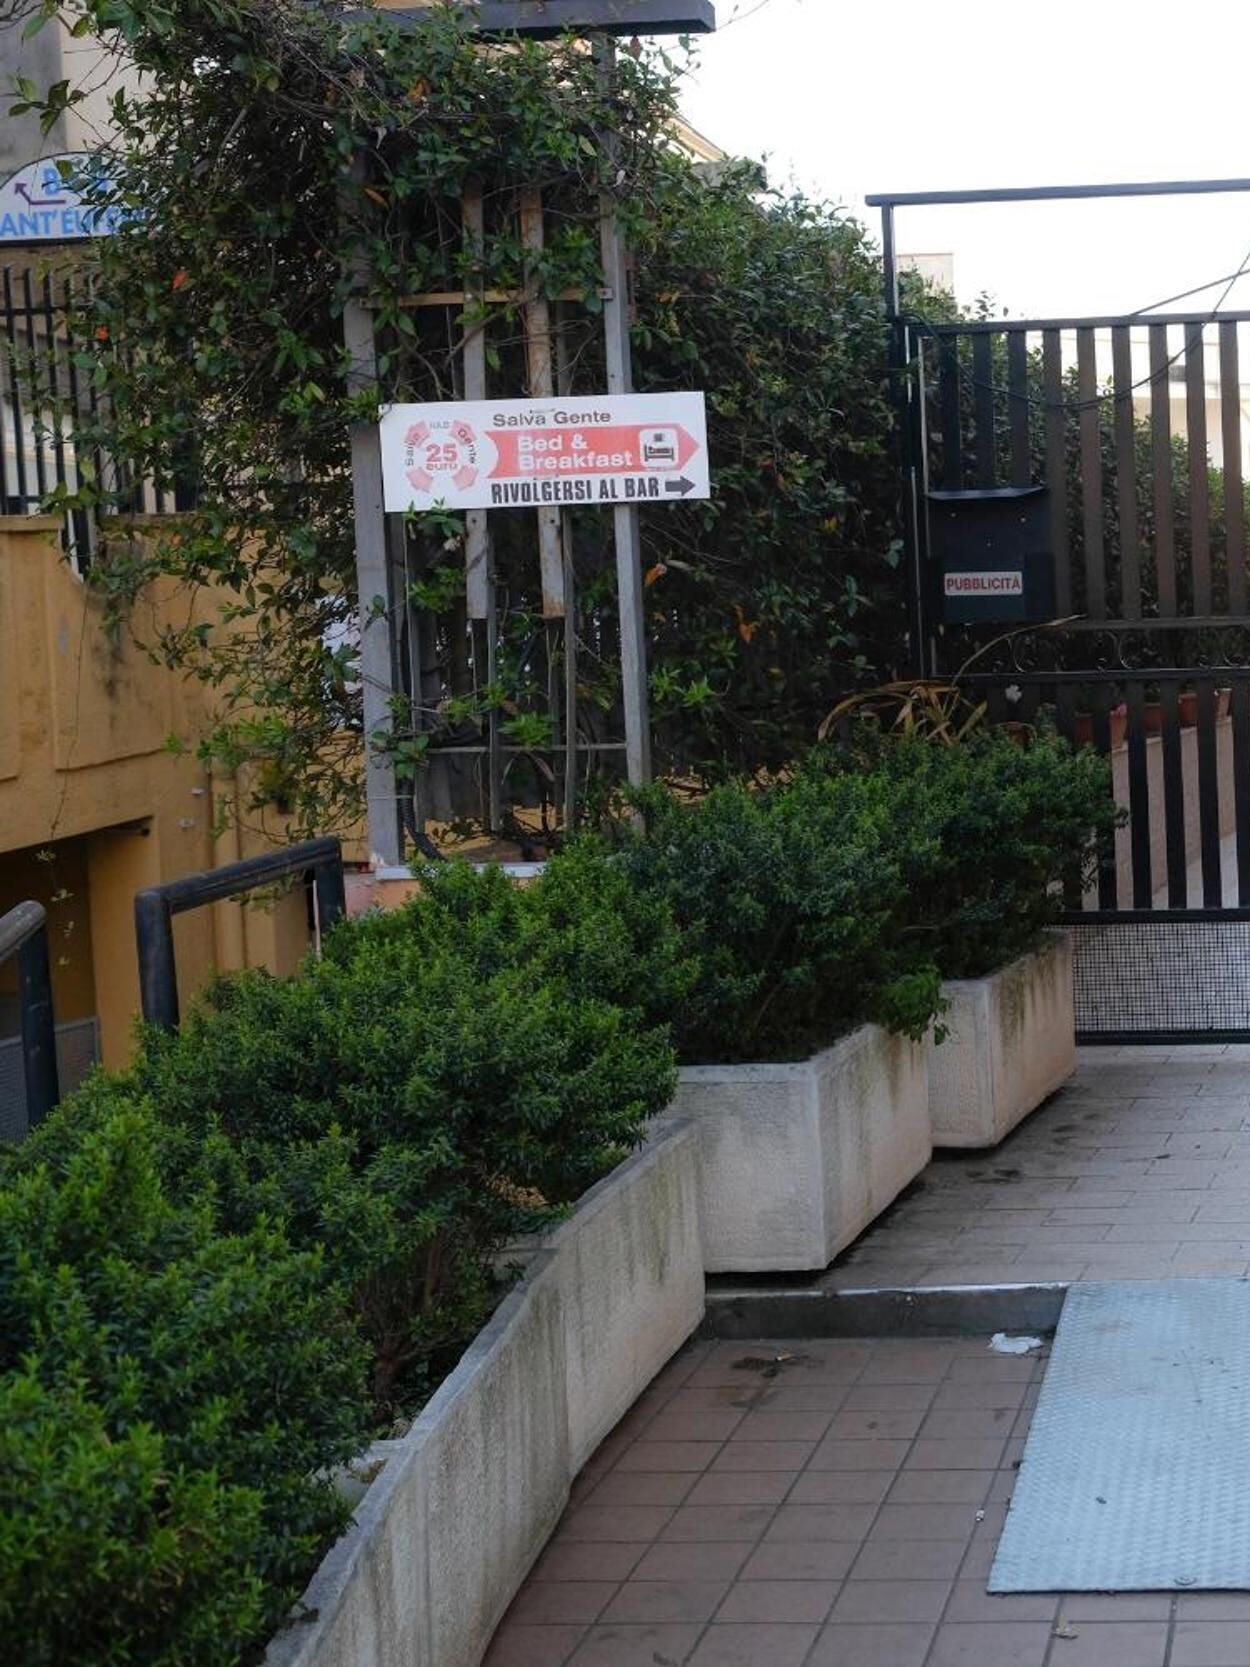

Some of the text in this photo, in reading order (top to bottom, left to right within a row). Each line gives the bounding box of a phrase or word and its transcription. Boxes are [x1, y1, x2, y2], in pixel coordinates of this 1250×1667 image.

[493, 410, 611, 427] Salva Gente
[517, 433, 588, 452] Bed &
[426, 443, 458, 462] 25
[518, 450, 634, 471] Breakfast
[425, 462, 458, 471] euro
[491, 477, 660, 504] RIVOLGERSI AL BAR
